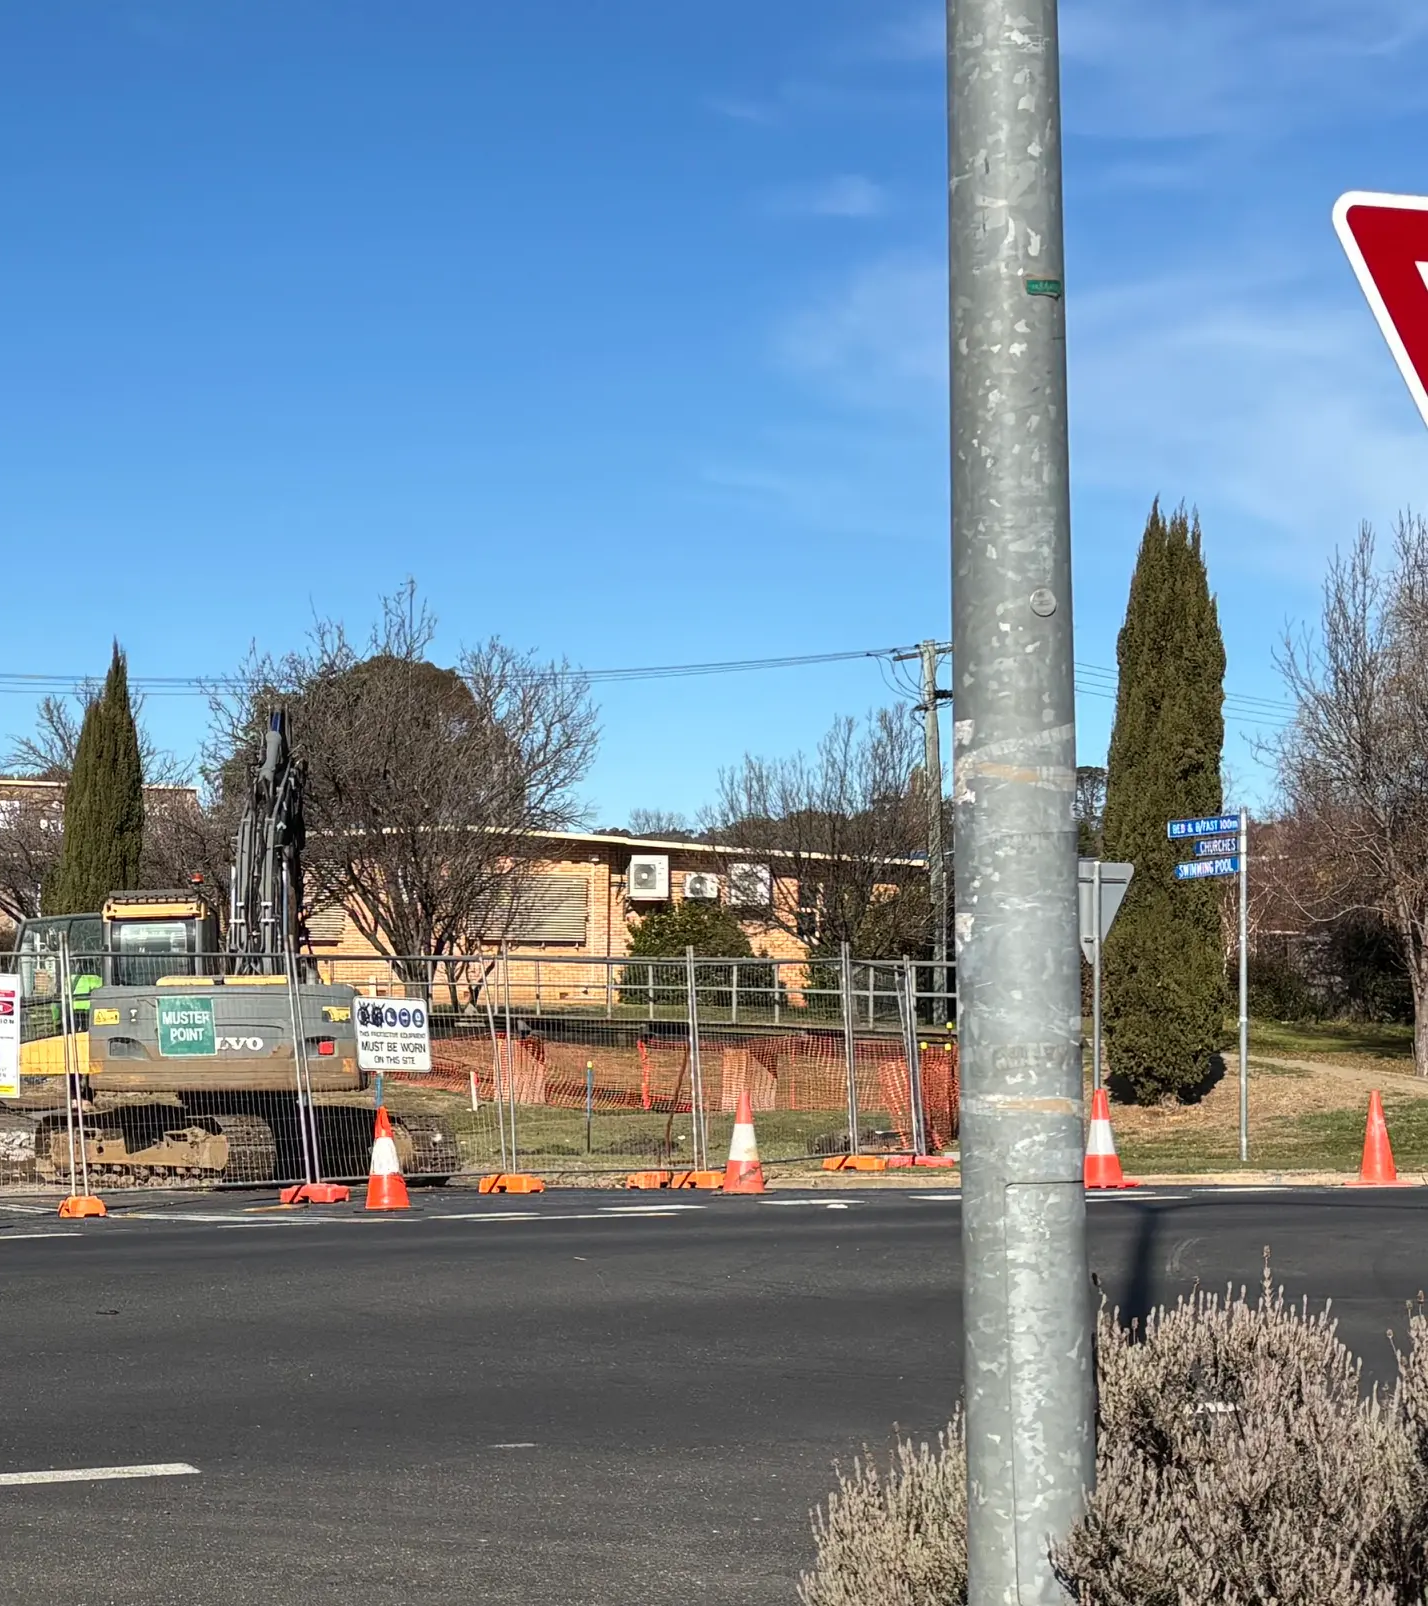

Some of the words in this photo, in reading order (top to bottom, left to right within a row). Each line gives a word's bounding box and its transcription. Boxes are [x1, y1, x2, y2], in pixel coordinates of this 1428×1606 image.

[1172, 823, 1186, 834] BED
[1187, 822, 1194, 832] &
[1199, 838, 1236, 853] CHURCHES
[1178, 860, 1214, 877] SWIMMING
[1215, 859, 1234, 873] POOL
[162, 1011, 210, 1025] MUSTER
[170, 1027, 205, 1042] POINT
[216, 1037, 264, 1051] LVO
[361, 1041, 384, 1052] MUST
[387, 1042, 398, 1052] BE
[400, 1042, 426, 1053] WORN
[374, 1055, 384, 1064] ON
[386, 1056, 400, 1065] THIS
[402, 1056, 416, 1065] SITE
